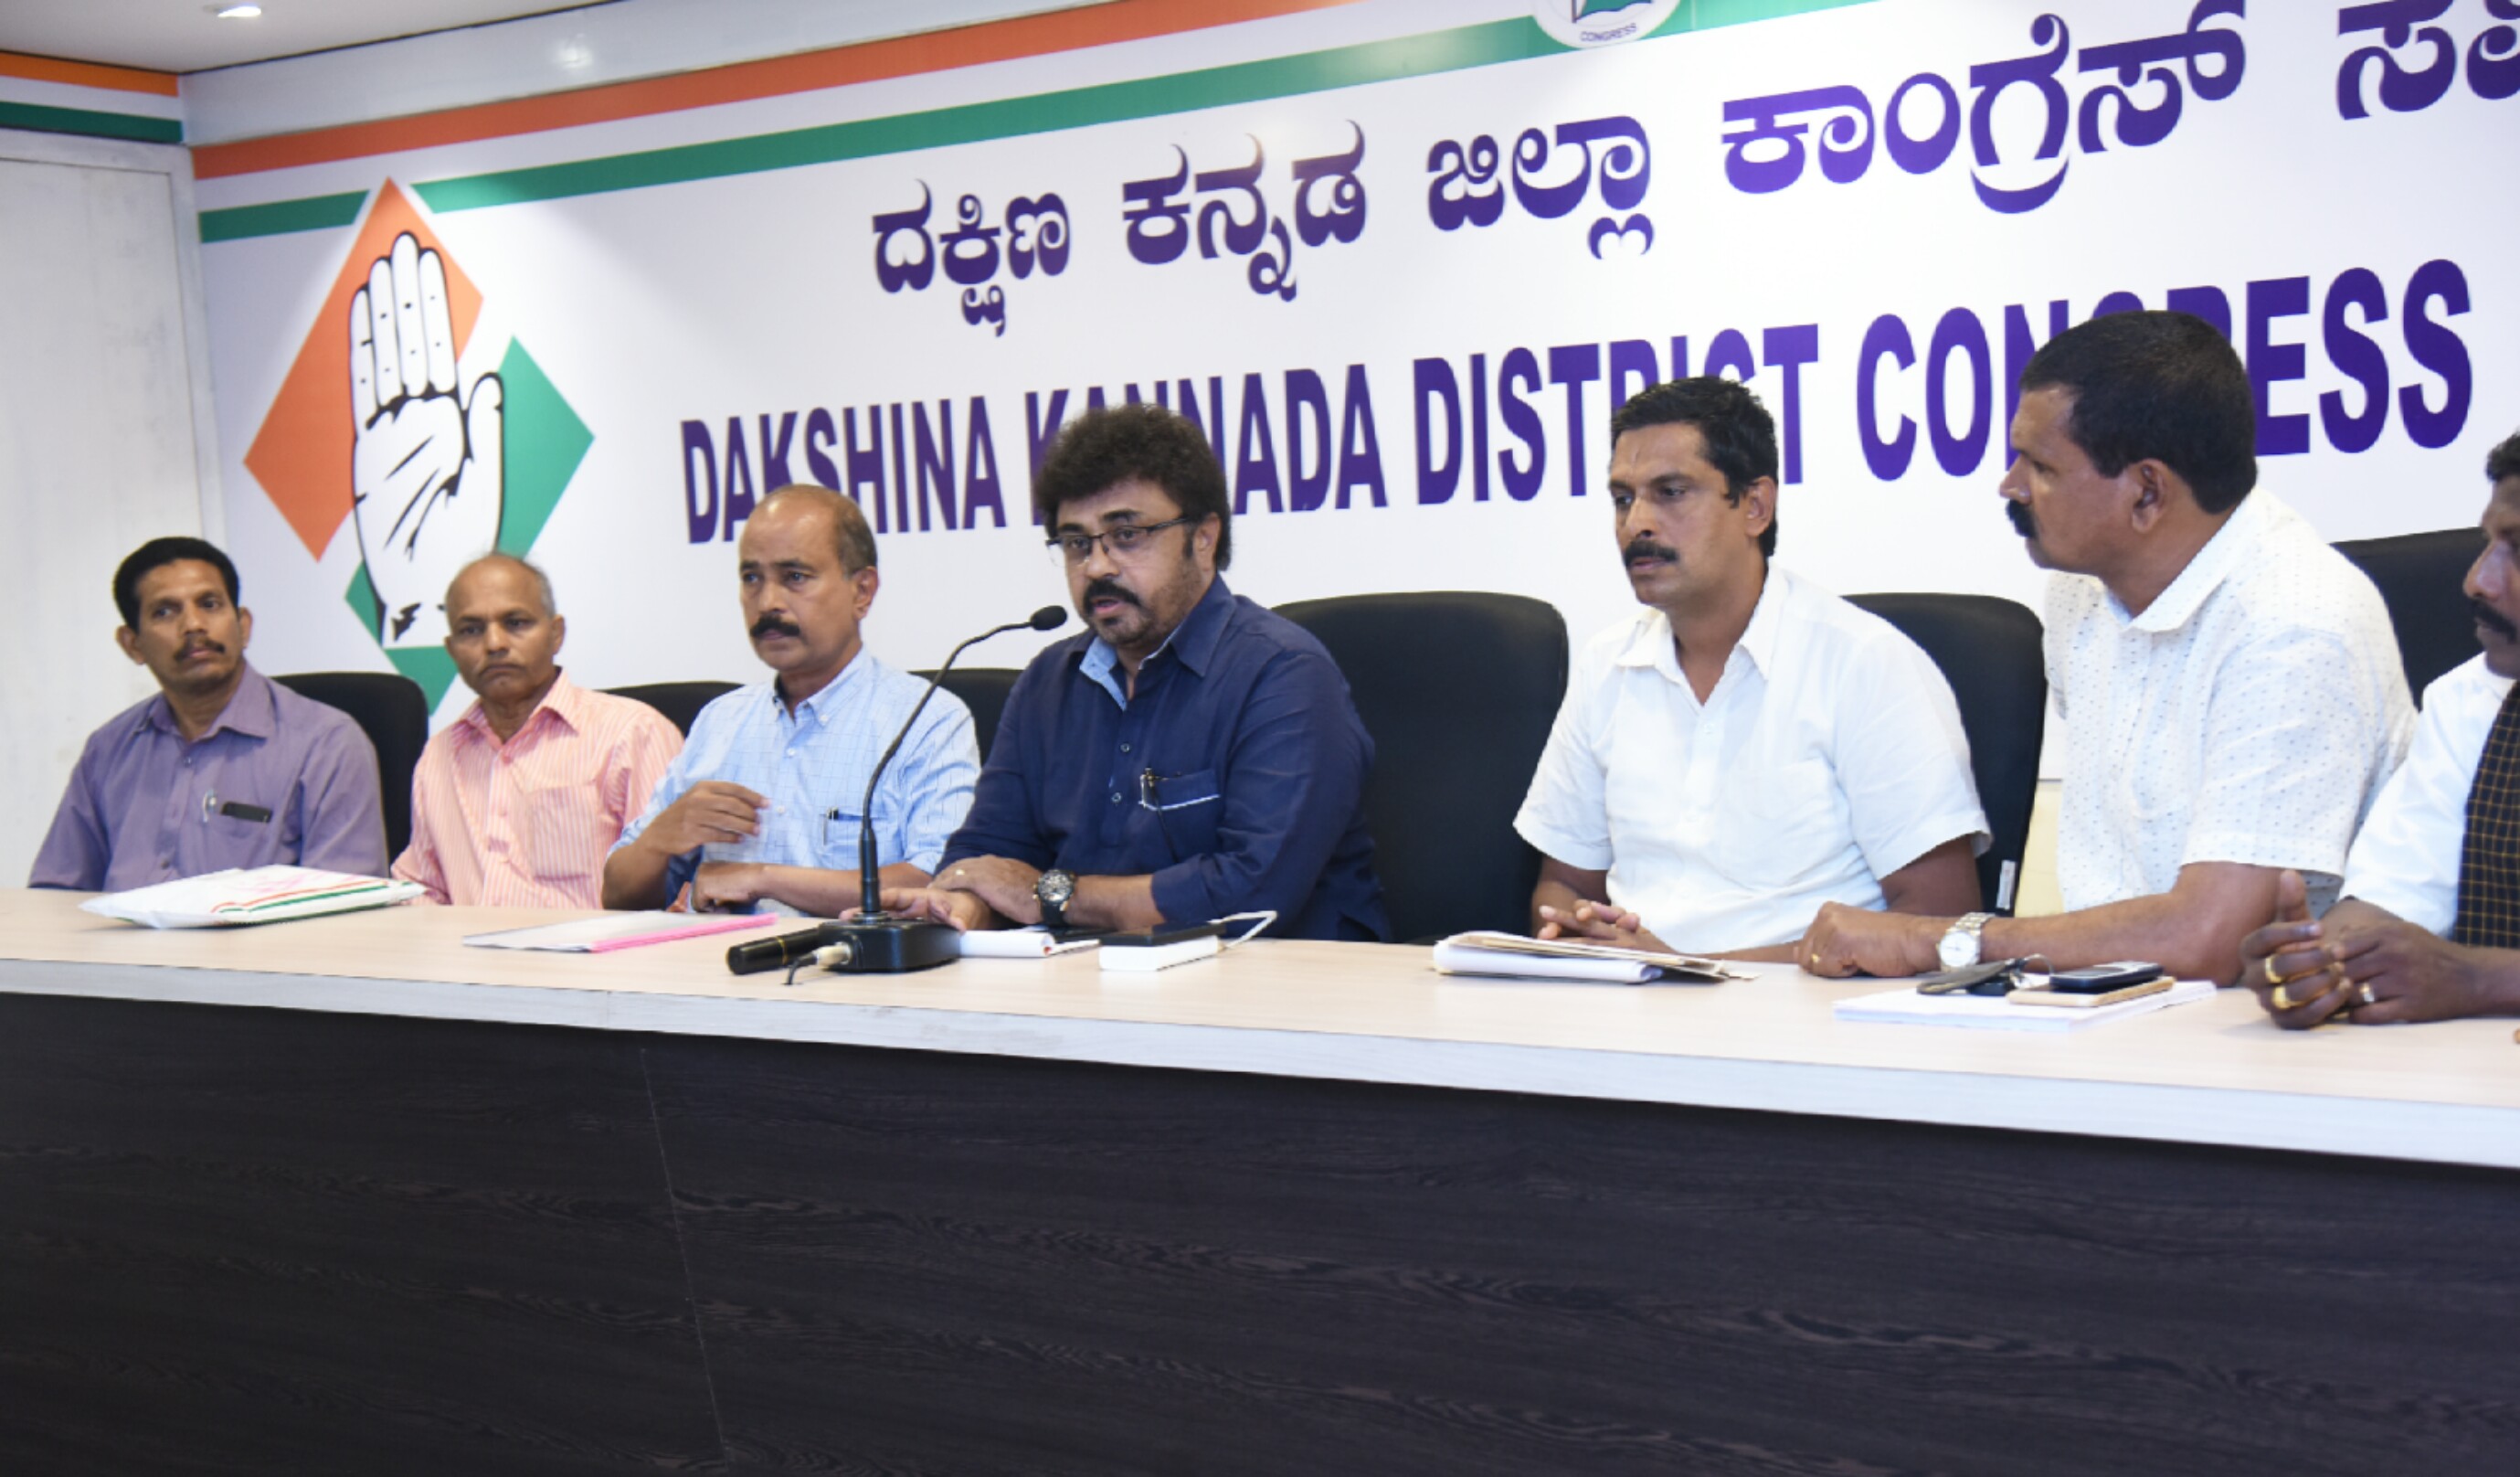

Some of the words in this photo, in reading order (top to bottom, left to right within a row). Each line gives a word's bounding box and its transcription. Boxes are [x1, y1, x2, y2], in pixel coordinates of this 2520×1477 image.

[872, 179, 1071, 337] ದಕ್ಷಿಣ
[1122, 120, 1367, 302] ಕನ್ನಡ
[1426, 115, 1654, 260] ಜಿಲ್ಲಾ
[1721, 0, 2247, 214] ಕಾಂಗ್ರೆಸ್
[1580, 23, 1636, 42] CONGRESS
[681, 395, 1008, 544] DAKSHINA
[1413, 324, 1818, 505] DISTT
[1857, 259, 2472, 482] COESS
